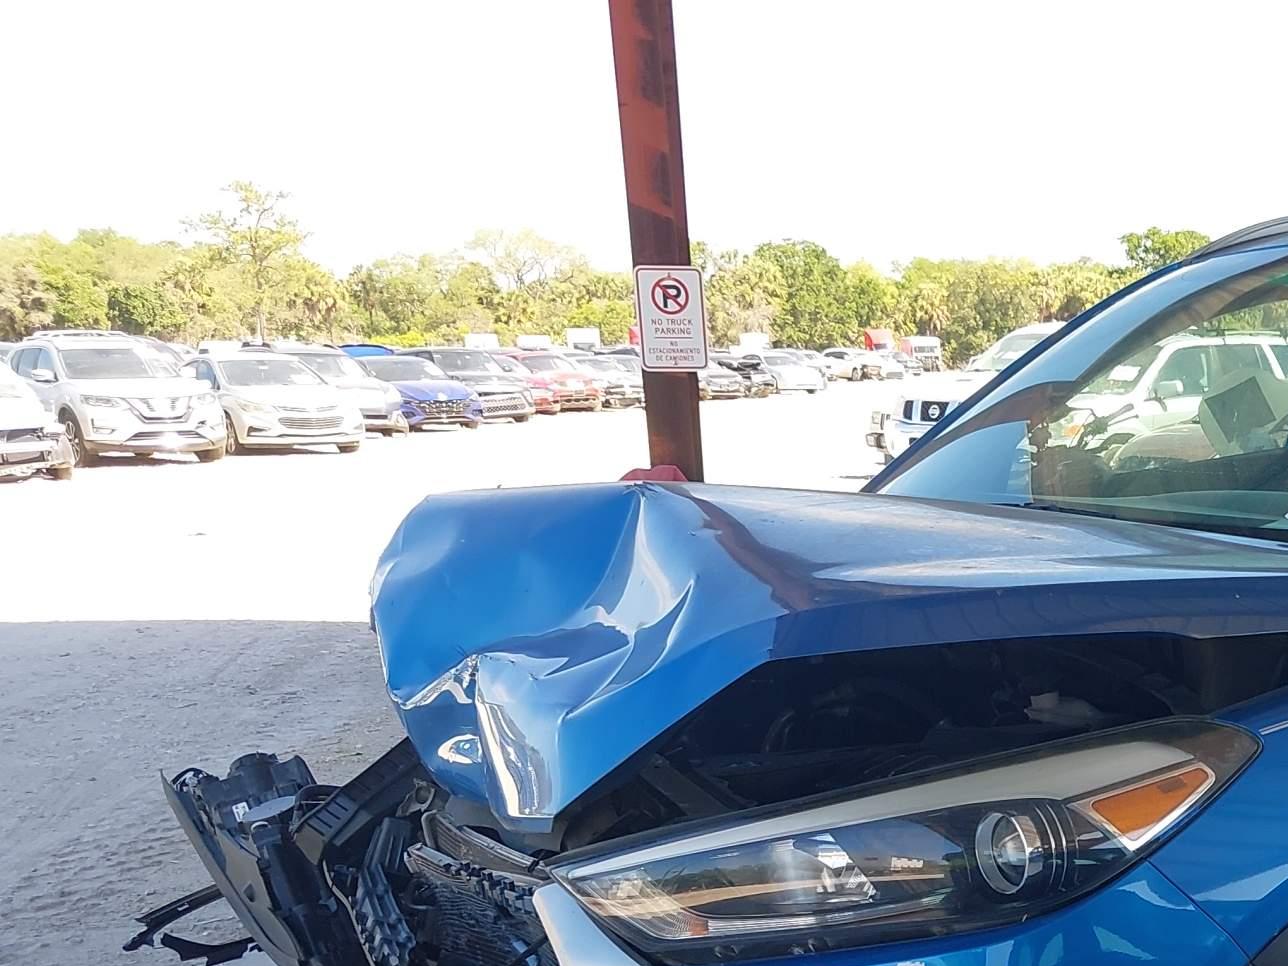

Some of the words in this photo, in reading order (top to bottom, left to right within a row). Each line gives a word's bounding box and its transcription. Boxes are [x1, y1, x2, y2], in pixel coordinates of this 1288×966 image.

[651, 318, 663, 326] NO
[665, 318, 694, 326] TRUCK
[654, 327, 692, 335] PARKING
